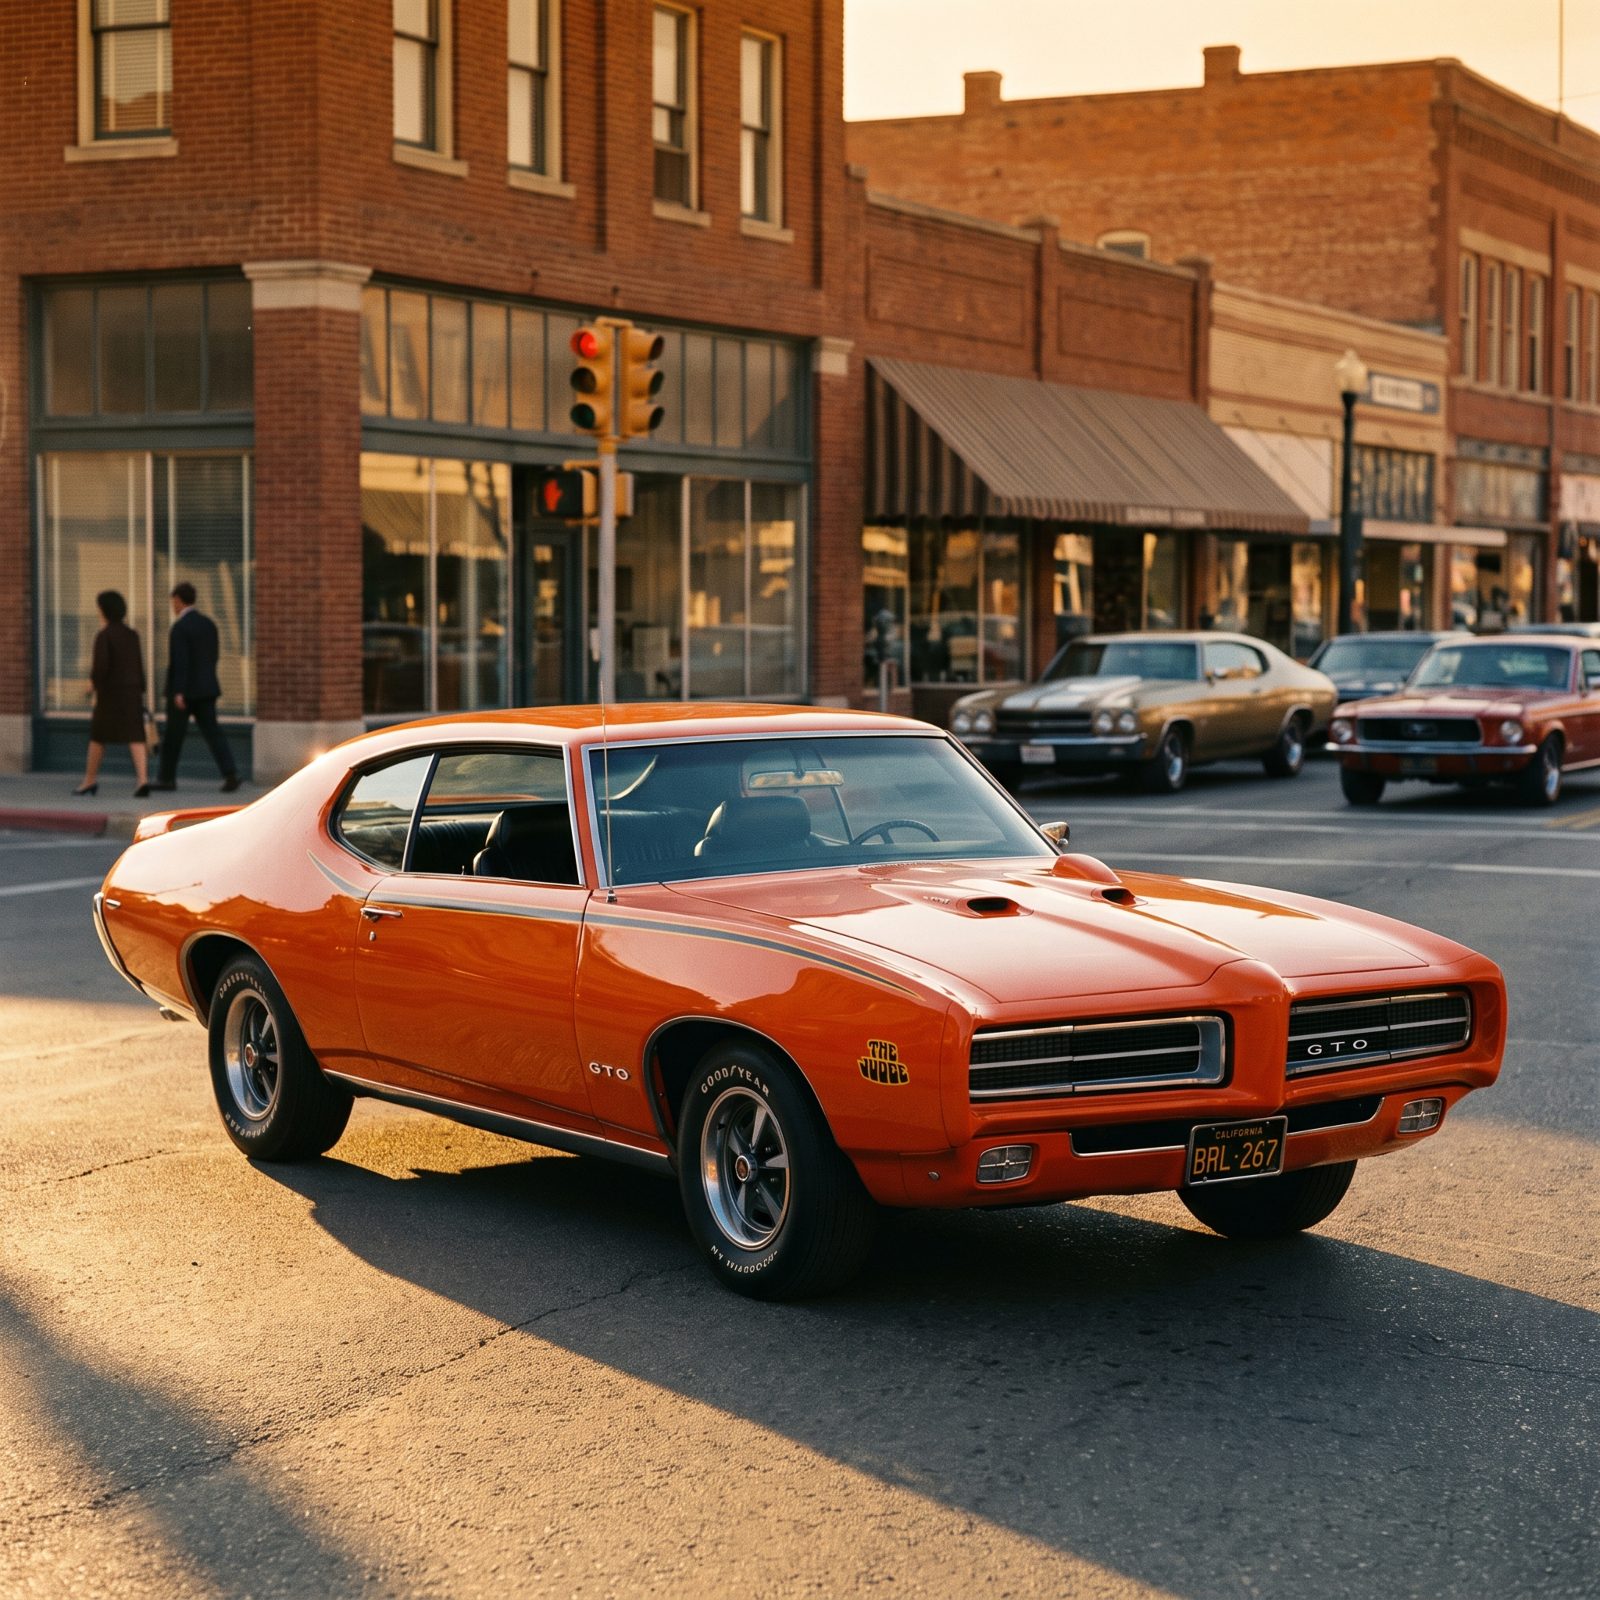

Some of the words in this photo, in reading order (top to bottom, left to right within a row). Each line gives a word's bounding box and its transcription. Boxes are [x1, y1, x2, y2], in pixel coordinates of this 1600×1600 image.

[867, 1040, 898, 1062] THE
[1307, 1039, 1368, 1055] GTO
[589, 1062, 629, 1081] GTO
[858, 1057, 910, 1085] JUDGE
[1215, 1127, 1263, 1140] CALIFORNIA
